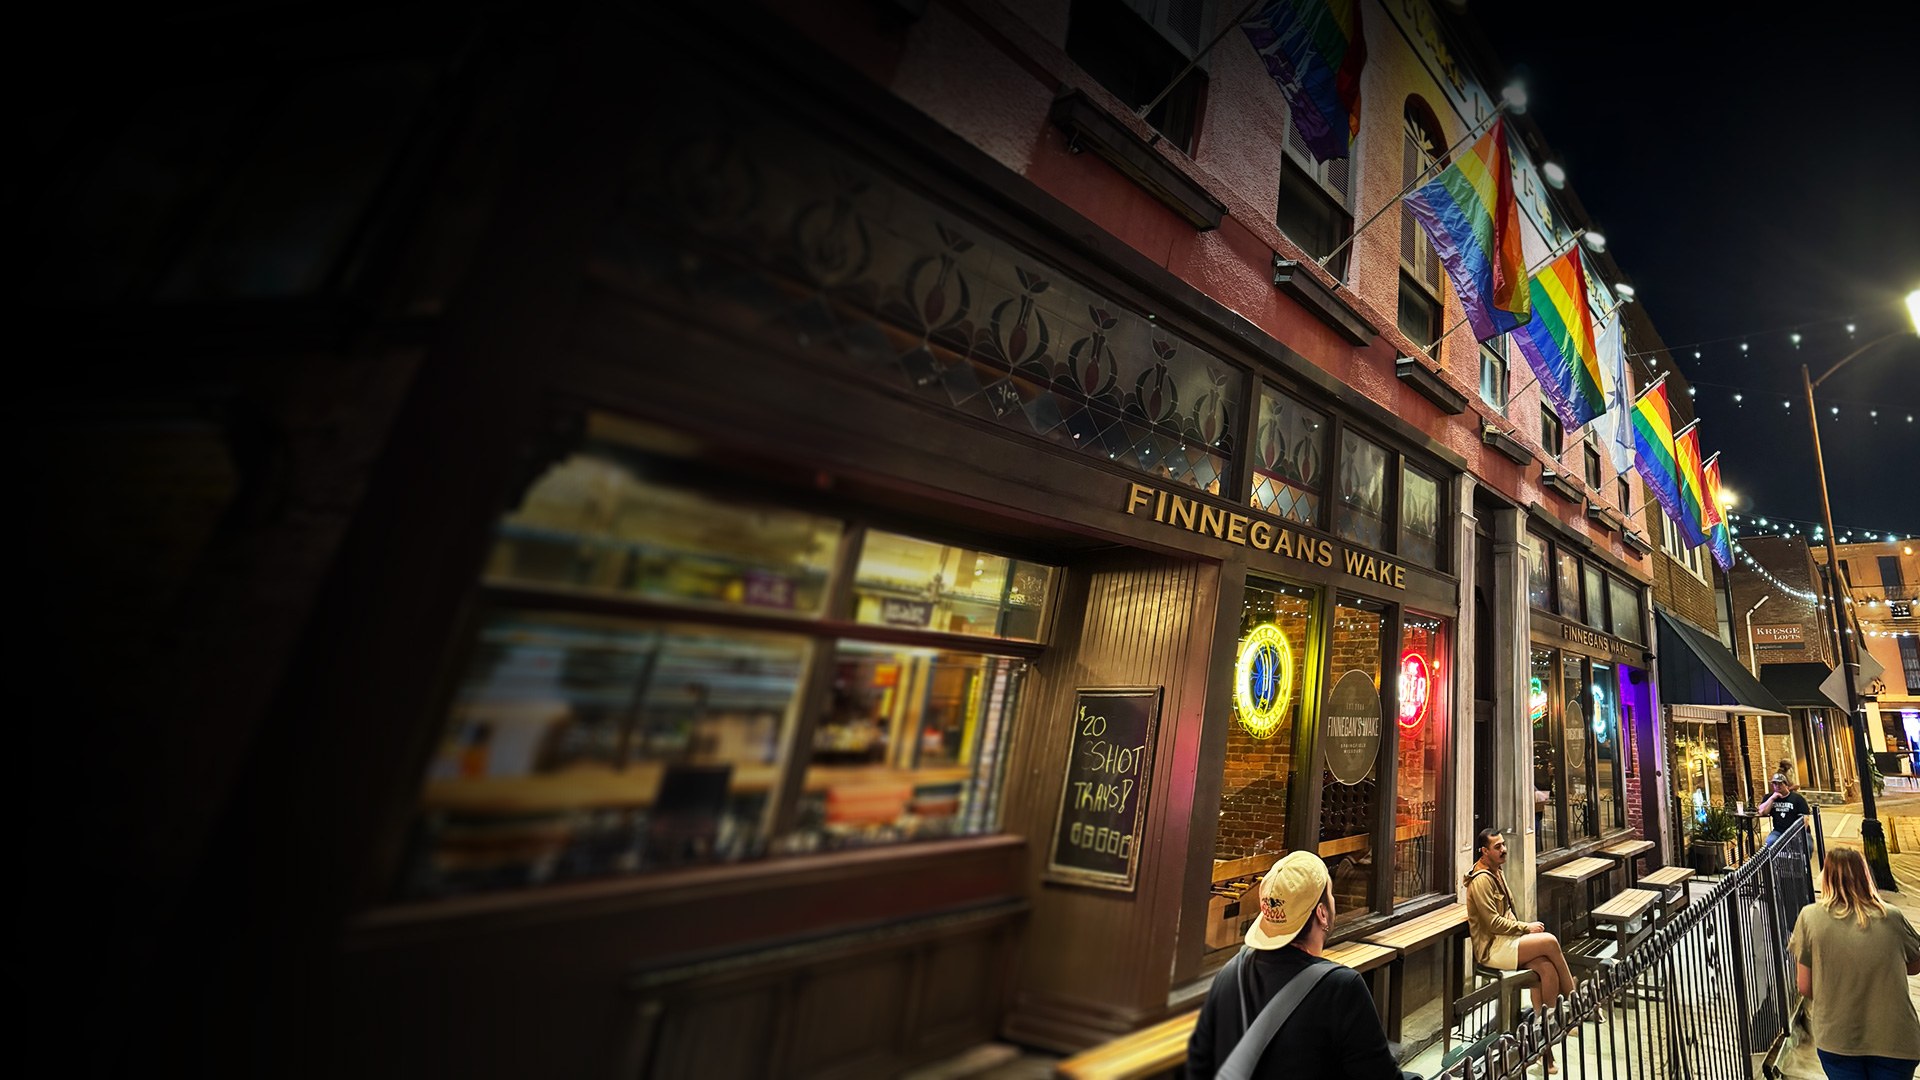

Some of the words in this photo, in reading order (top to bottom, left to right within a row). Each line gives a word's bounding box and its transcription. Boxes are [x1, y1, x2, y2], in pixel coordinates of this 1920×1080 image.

[1126, 483, 1333, 567] FINNEGANS
[1343, 548, 1406, 590] WAKE
[1563, 624, 1609, 652] FINNEGANS
[1609, 639, 1628, 657] WAKE
[1756, 627, 1800, 635] KRESGE
[1327, 716, 1362, 737] FINNEGAN'S
[1362, 716, 1379, 737] WAKE
[1090, 740, 1145, 776] SHOT
